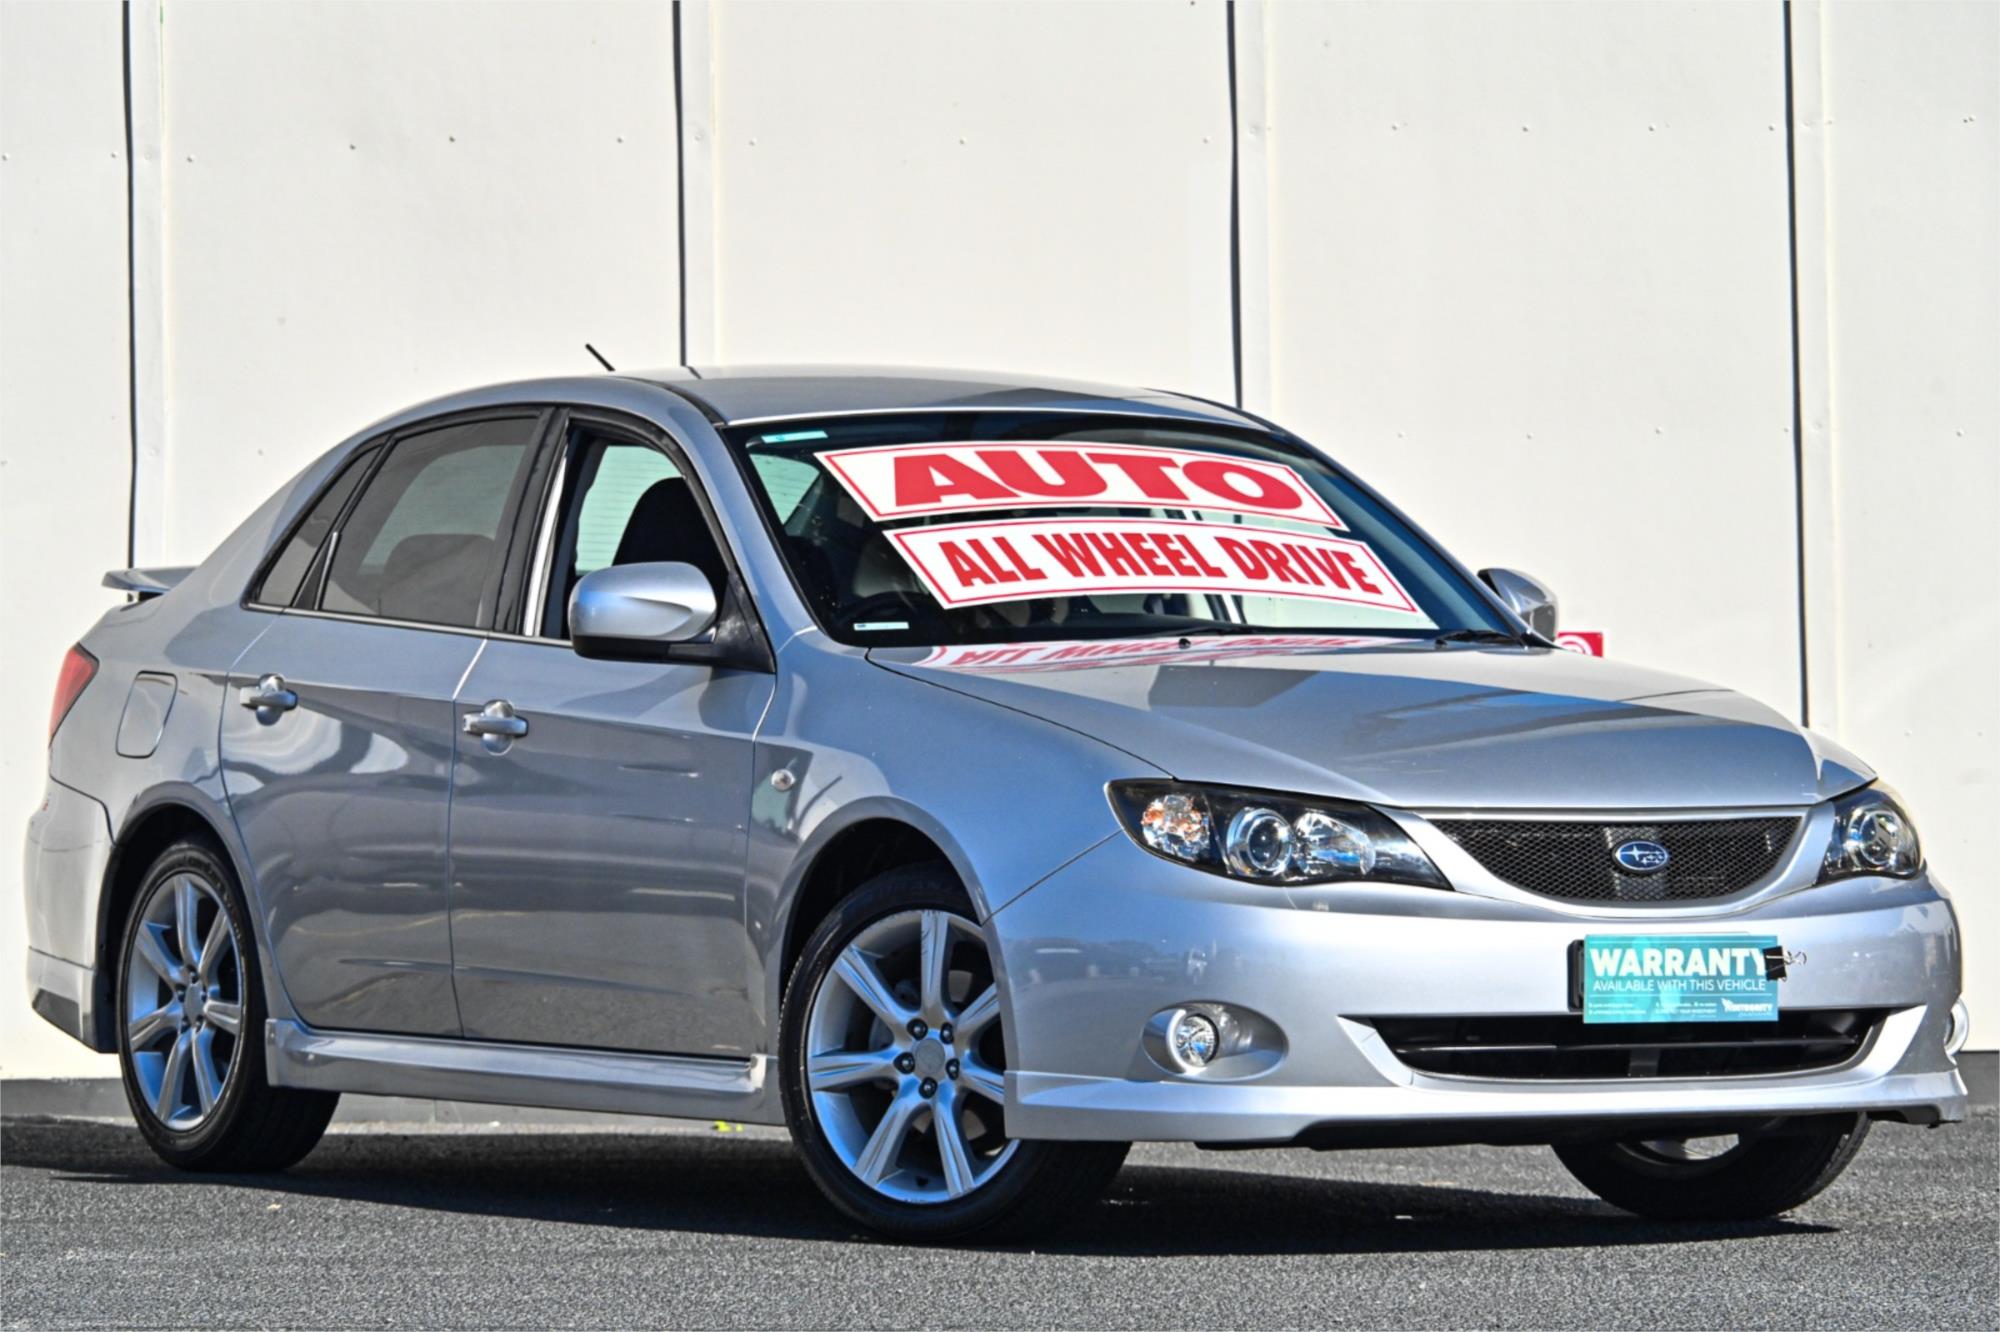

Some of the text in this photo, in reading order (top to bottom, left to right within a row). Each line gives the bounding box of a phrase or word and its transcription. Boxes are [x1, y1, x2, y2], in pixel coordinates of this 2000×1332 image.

[895, 451, 1302, 509] AUTO
[939, 532, 1382, 595] ALL WHEEL DRIVE
[1590, 948, 1766, 977] WARRANTY
[1593, 978, 1766, 992] AVAILABLE WITH THIS VEHICLE
